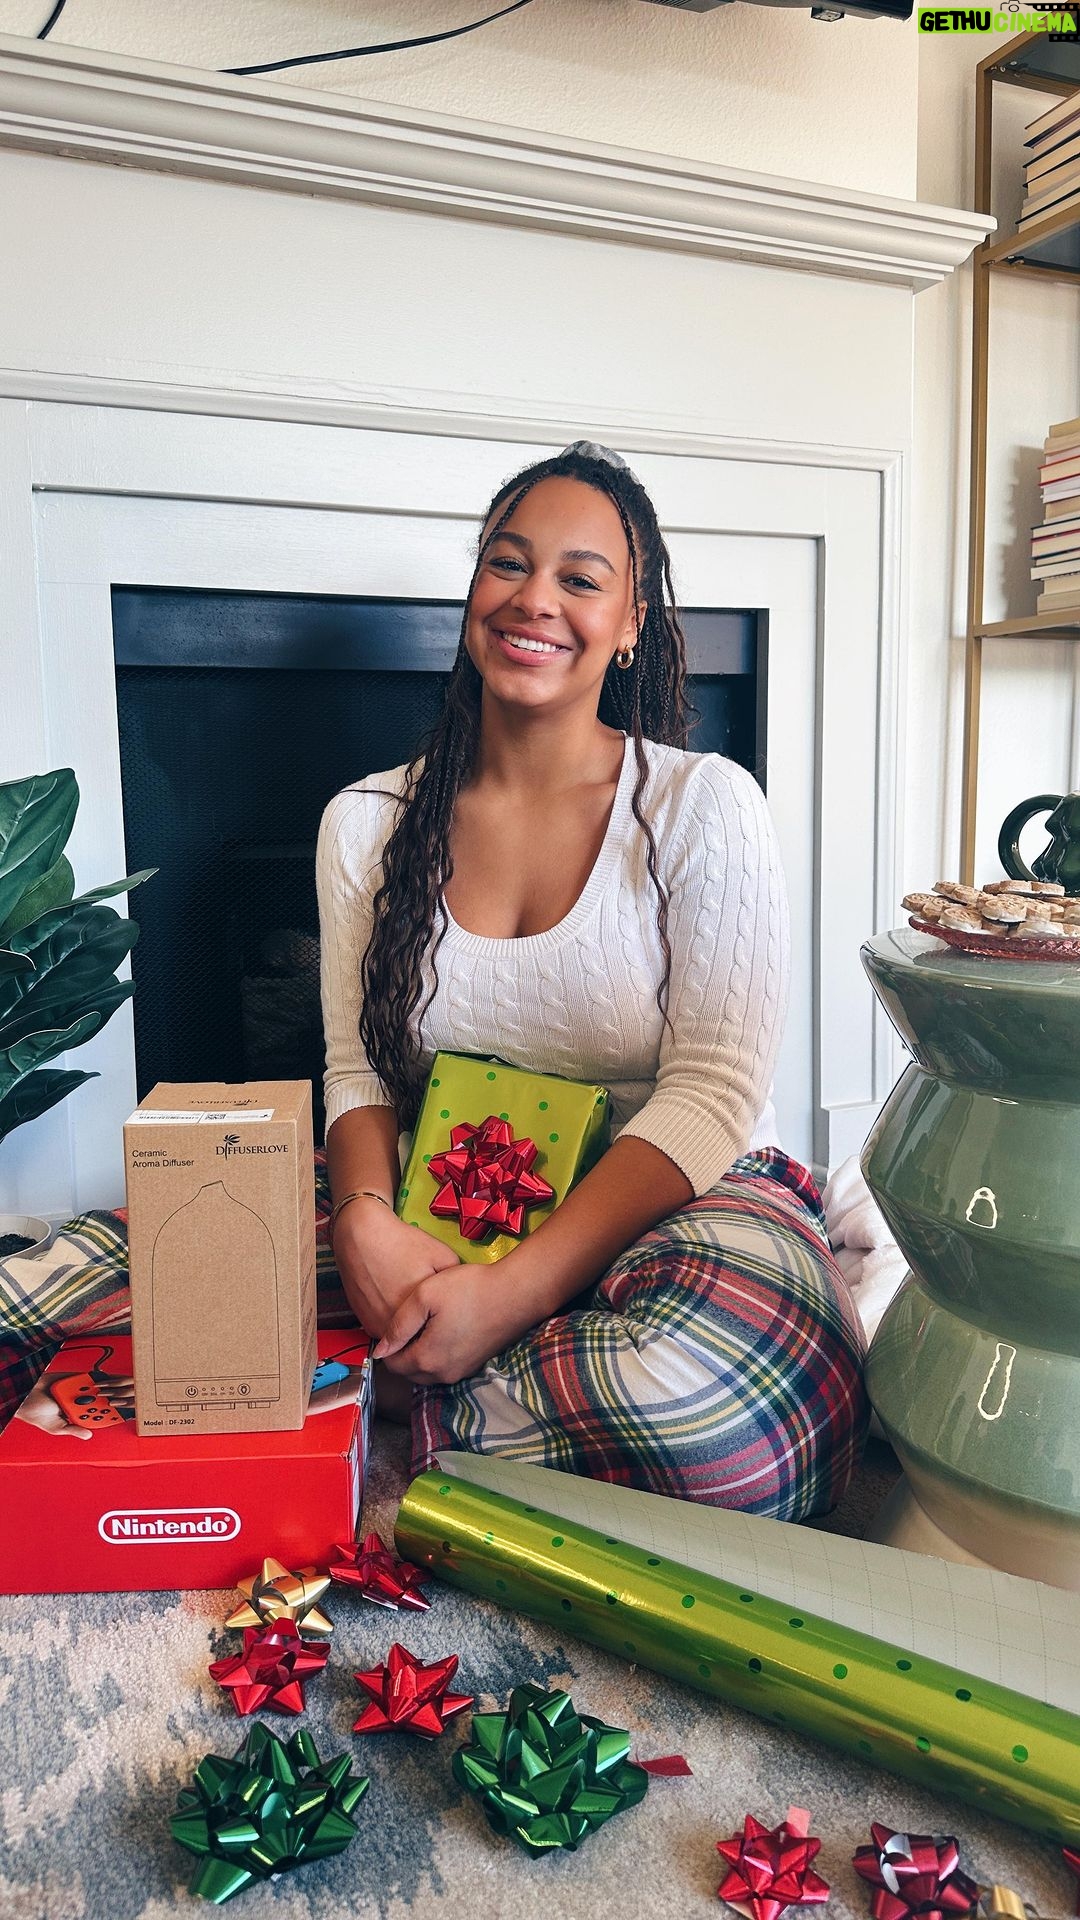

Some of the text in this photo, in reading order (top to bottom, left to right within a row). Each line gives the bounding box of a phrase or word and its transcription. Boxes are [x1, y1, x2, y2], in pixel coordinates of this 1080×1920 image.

[132, 1149, 168, 1158] Ceramic
[215, 1143, 289, 1159] DIFFUSERLOVE
[132, 1158, 195, 1168] Aroma Diffuser
[111, 1516, 228, 1536] Nintendo
